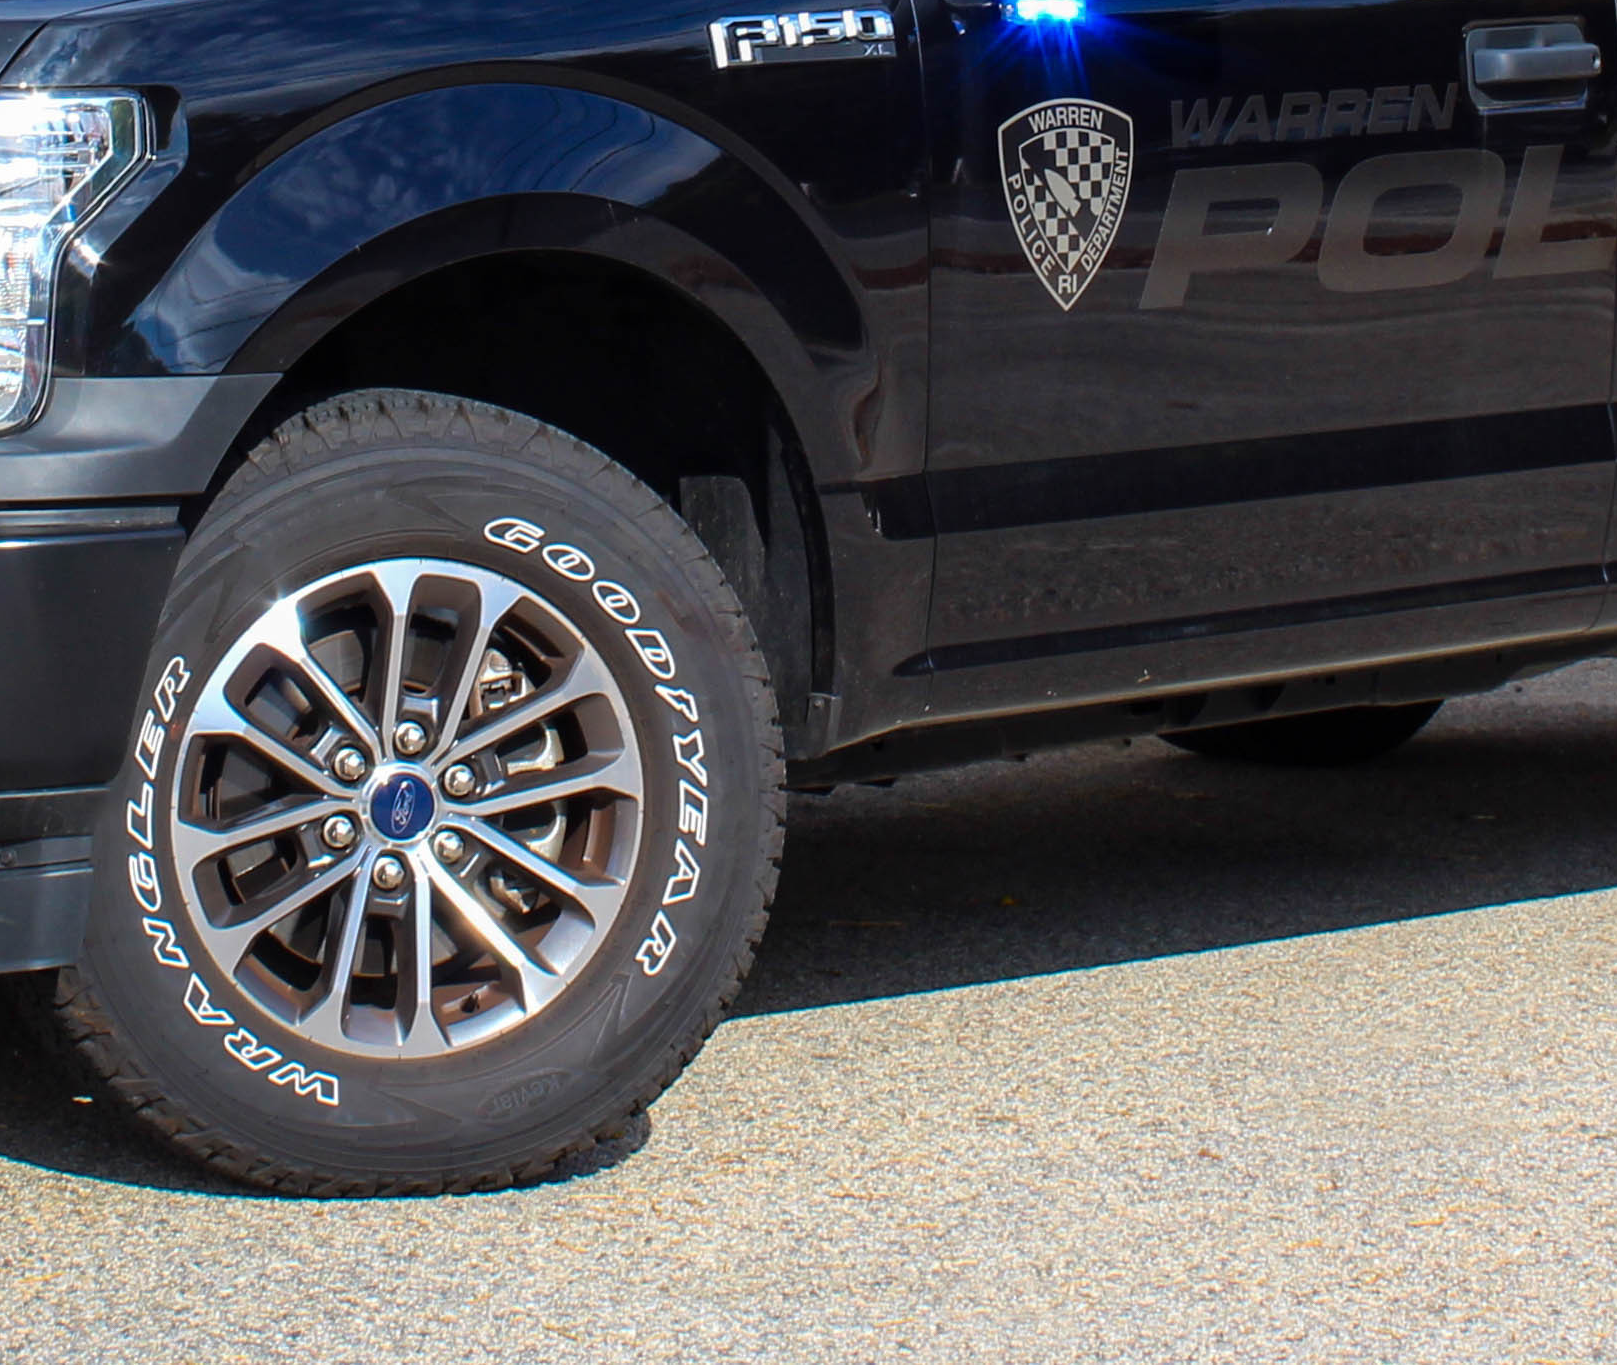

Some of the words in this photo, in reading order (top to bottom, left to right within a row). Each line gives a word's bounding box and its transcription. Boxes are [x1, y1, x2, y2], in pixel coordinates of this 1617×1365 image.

[1028, 106, 1102, 133] WARREN
[1170, 82, 1459, 148] WARREN
[1008, 175, 1055, 276] POLICE
[1080, 148, 1128, 272] DEPARTMENT
[1058, 274, 1077, 294] RI
[484, 517, 708, 976] GOODYEAR
[127, 655, 339, 1107] WRANGLER
